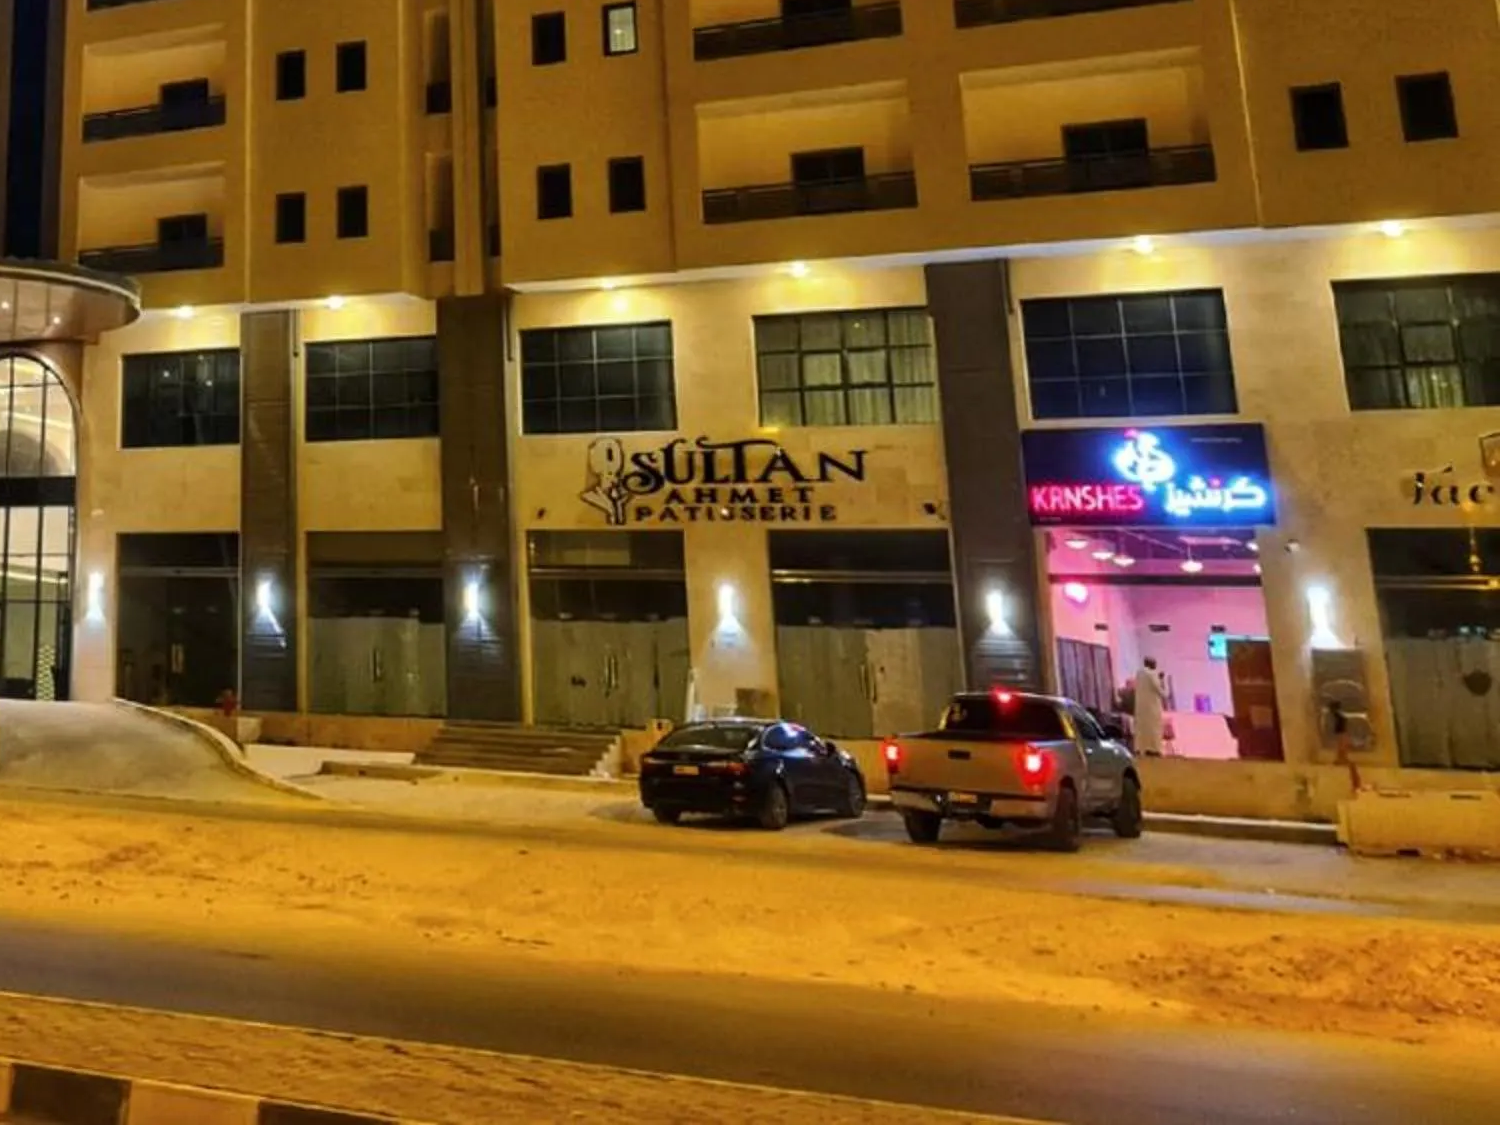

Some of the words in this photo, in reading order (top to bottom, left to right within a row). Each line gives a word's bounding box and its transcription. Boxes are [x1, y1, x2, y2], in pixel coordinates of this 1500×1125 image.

[622, 436, 869, 496] SULTAN
[664, 486, 815, 505] AHMET
[634, 504, 837, 522] PATISSERIE
